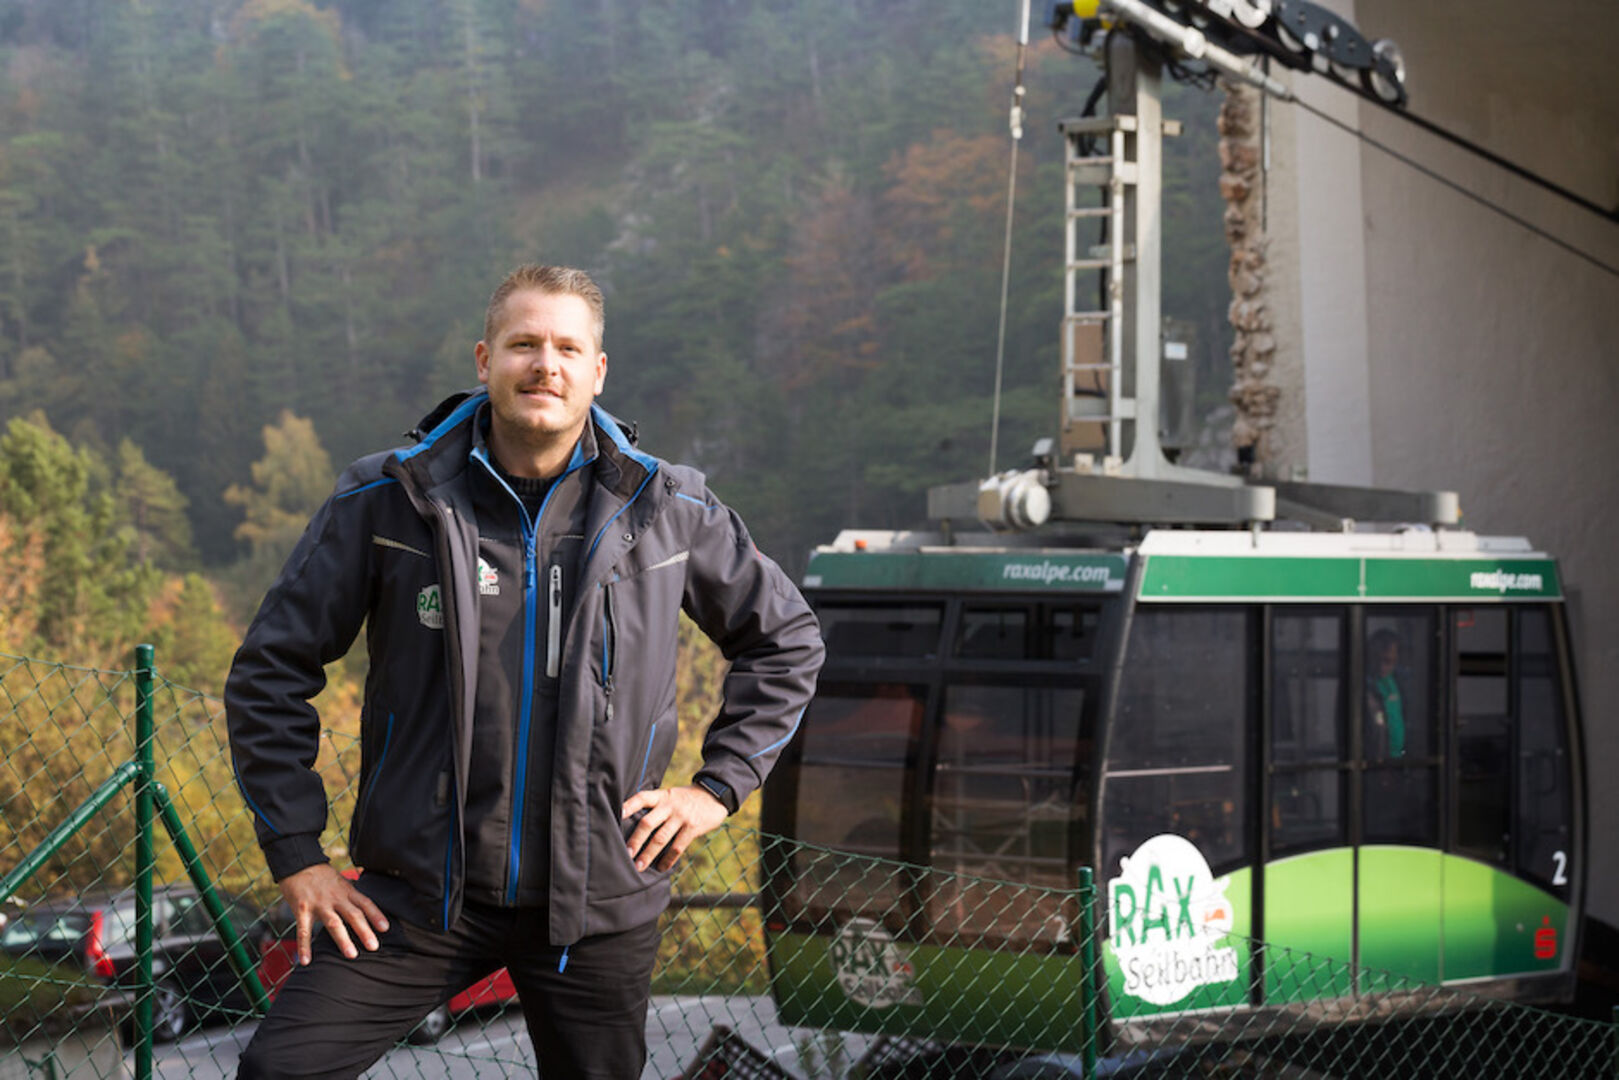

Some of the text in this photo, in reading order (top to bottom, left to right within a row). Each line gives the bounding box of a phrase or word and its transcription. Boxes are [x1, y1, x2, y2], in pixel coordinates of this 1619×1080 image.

[1002, 560, 1111, 586] raxalpe.com
[417, 589, 441, 613] RA
[1551, 850, 1568, 886] 2
[1114, 863, 1196, 948] RAX
[1052, 914, 1070, 943] 2
[831, 922, 892, 977] RAX
[1126, 945, 1236, 991] Seilbahn
